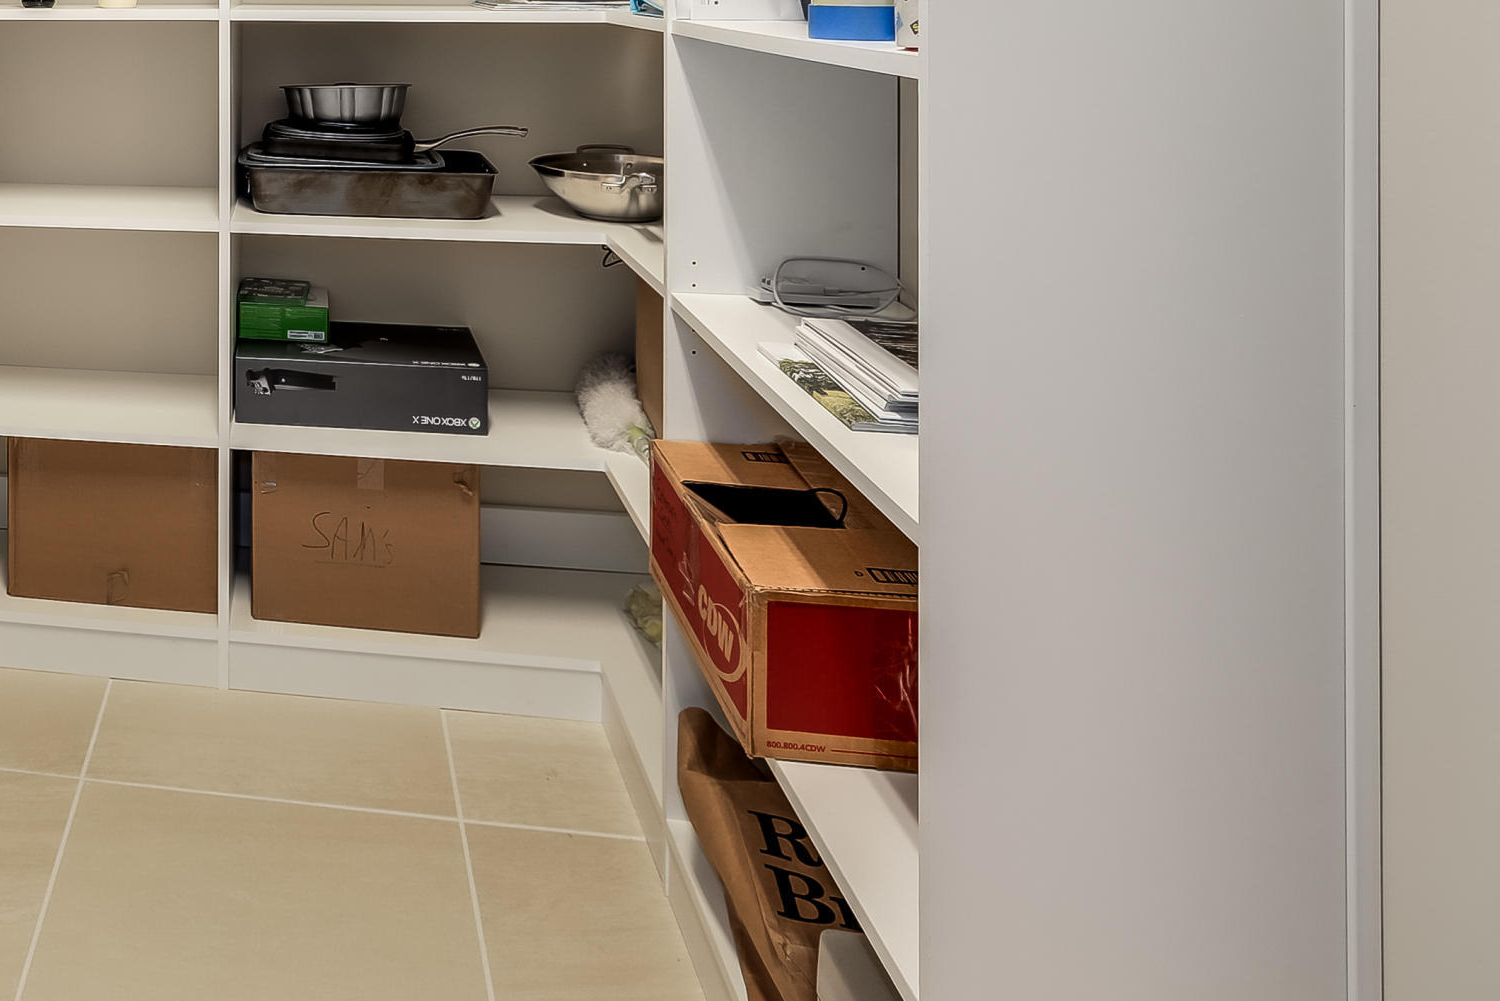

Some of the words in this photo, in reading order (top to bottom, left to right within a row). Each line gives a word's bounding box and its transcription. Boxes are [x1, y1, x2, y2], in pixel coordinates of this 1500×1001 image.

[411, 415, 420, 424] X
[420, 416, 441, 425] ONE
[441, 416, 467, 427] XBOX
[698, 584, 734, 663] CDW
[766, 740, 826, 753] 800.800.4CDW
